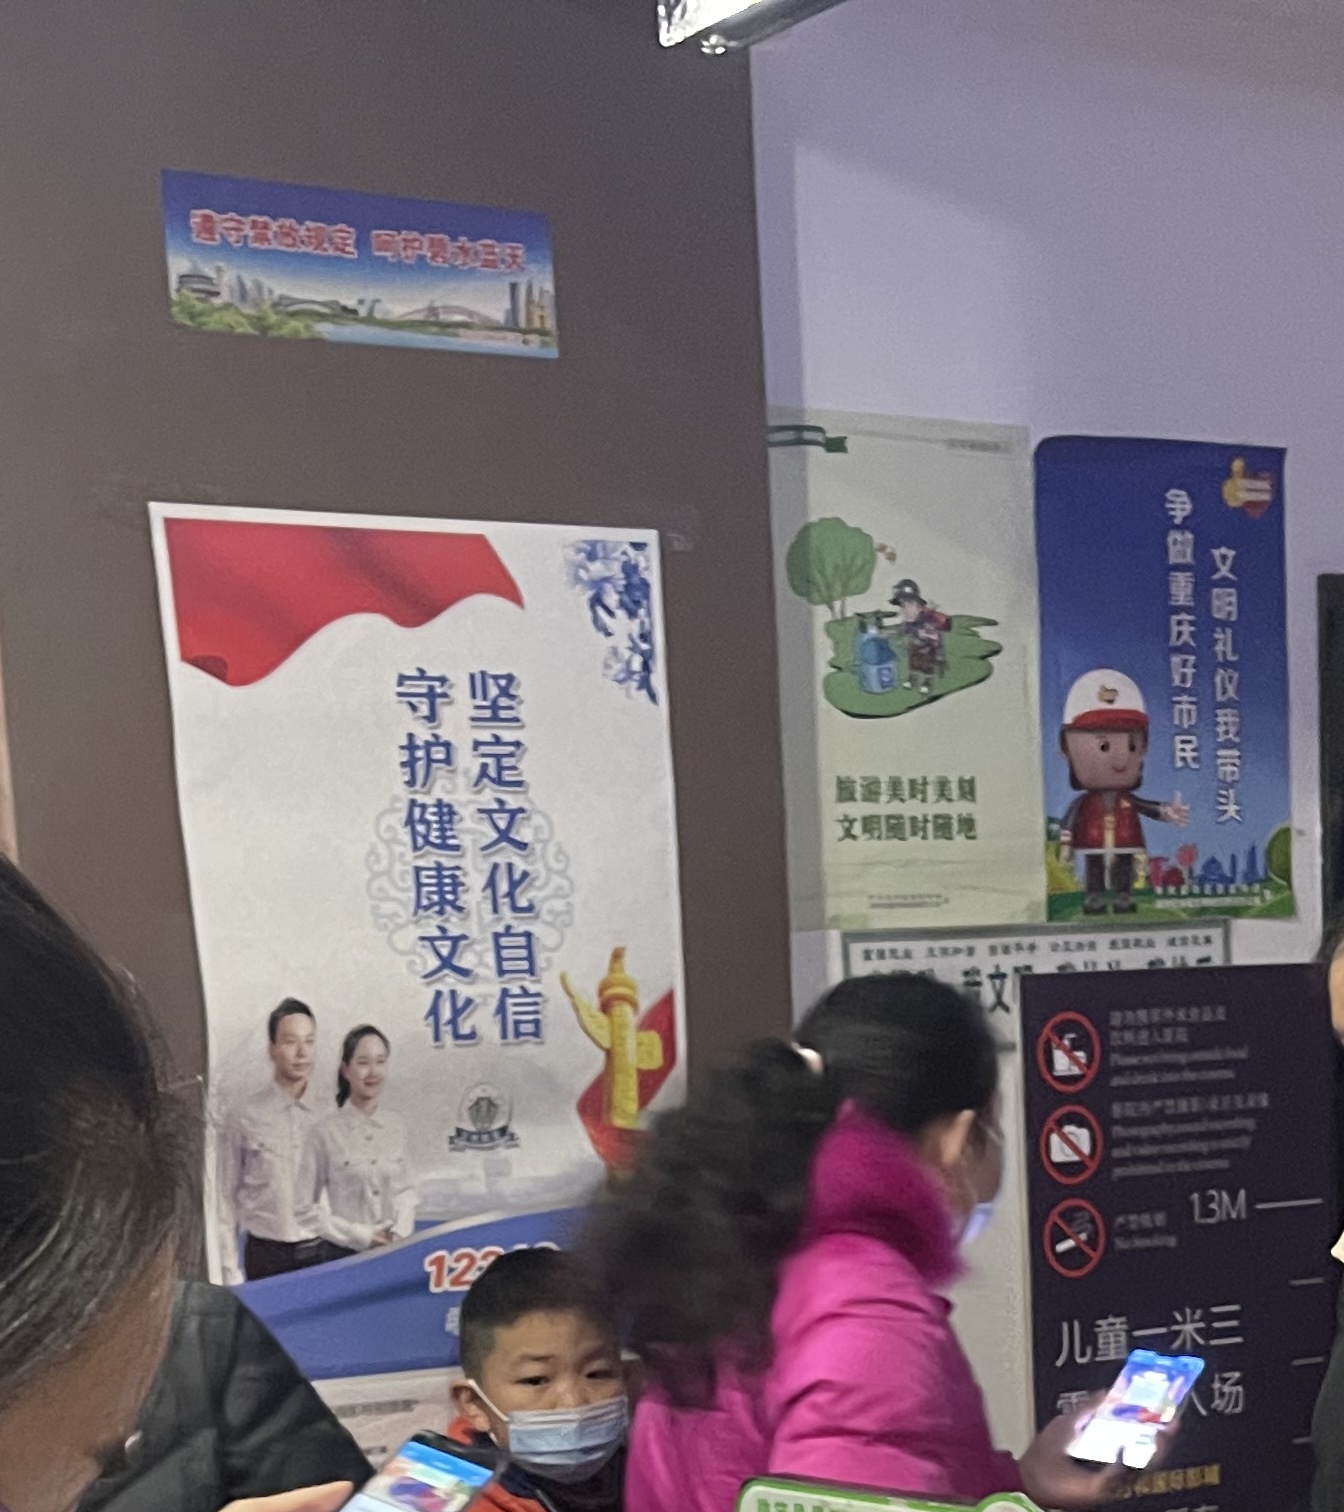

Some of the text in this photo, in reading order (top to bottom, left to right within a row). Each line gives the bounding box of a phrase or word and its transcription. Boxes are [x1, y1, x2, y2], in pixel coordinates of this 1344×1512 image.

[1164, 488, 1202, 770] 争做重庆好市民
[1211, 545, 1244, 824] 文明礼仪我带头
[395, 668, 477, 1044] 守护健康文化
[468, 670, 546, 1044] 坚定文化自信
[835, 813, 978, 842] 文明随时随地
[1056, 1304, 1244, 1367] 儿童一米三
